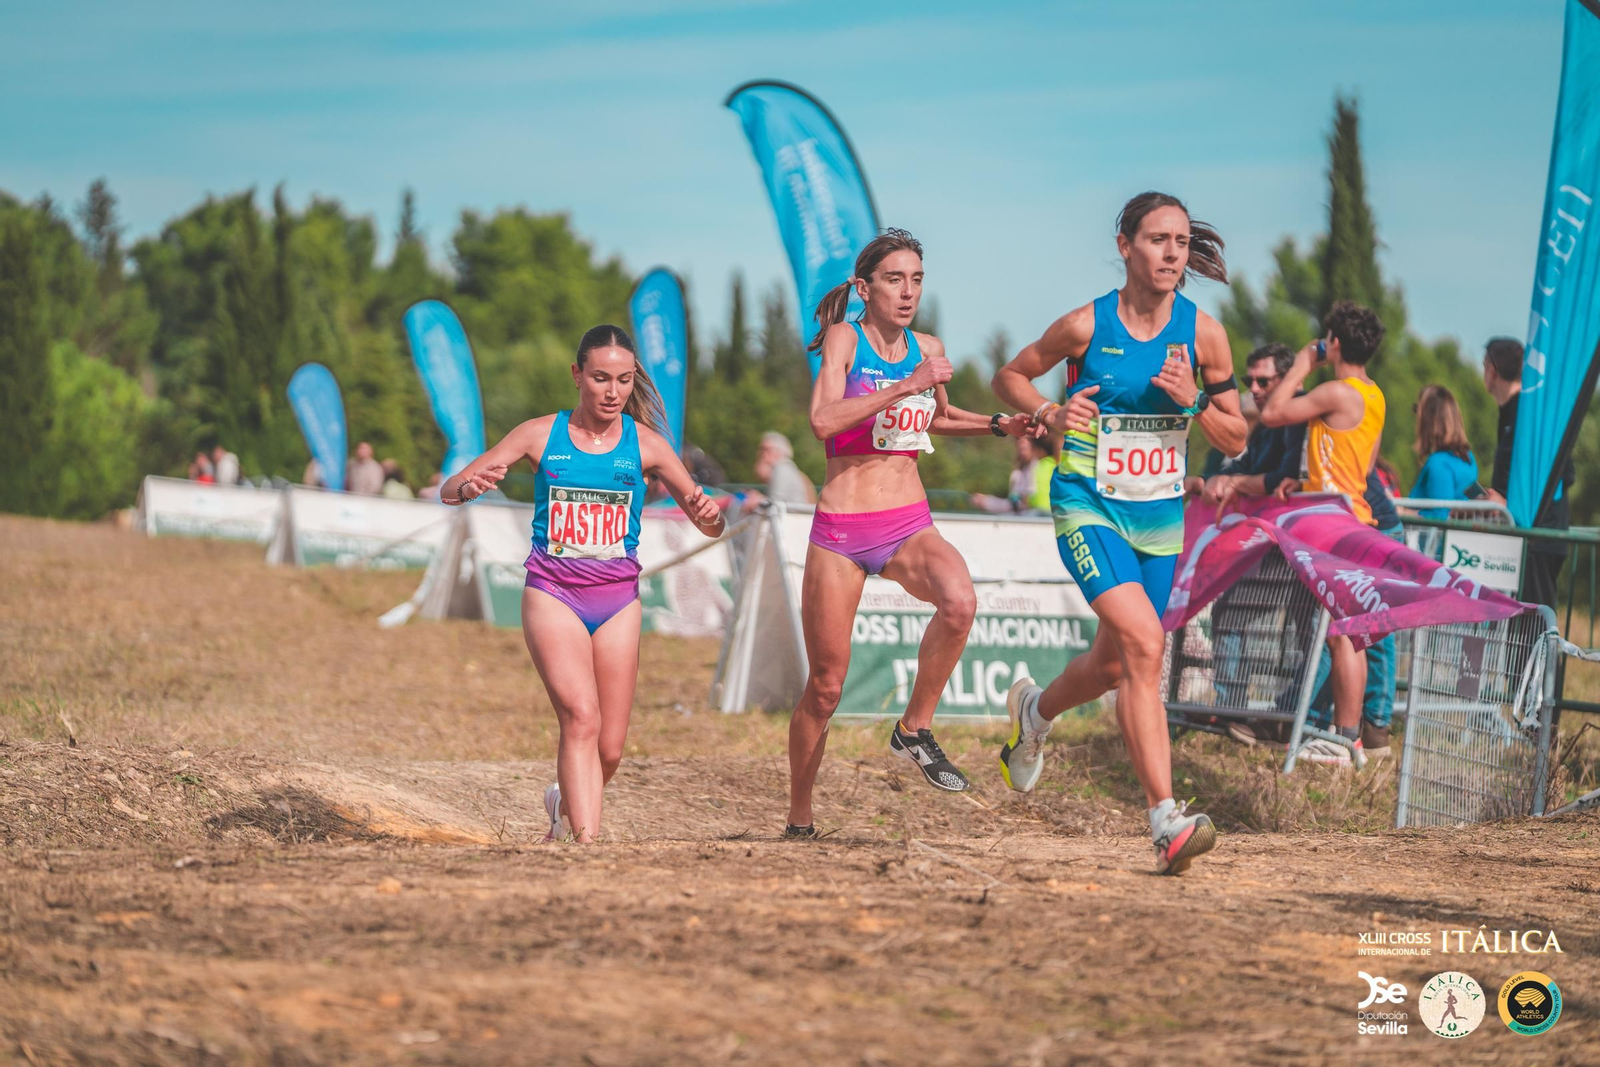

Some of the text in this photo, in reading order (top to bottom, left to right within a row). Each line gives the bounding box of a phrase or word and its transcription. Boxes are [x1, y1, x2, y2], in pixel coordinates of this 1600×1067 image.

[1106, 446, 1178, 476] 5001
[550, 501, 627, 546] CASTRO
[1484, 561, 1517, 574] Sevilla
